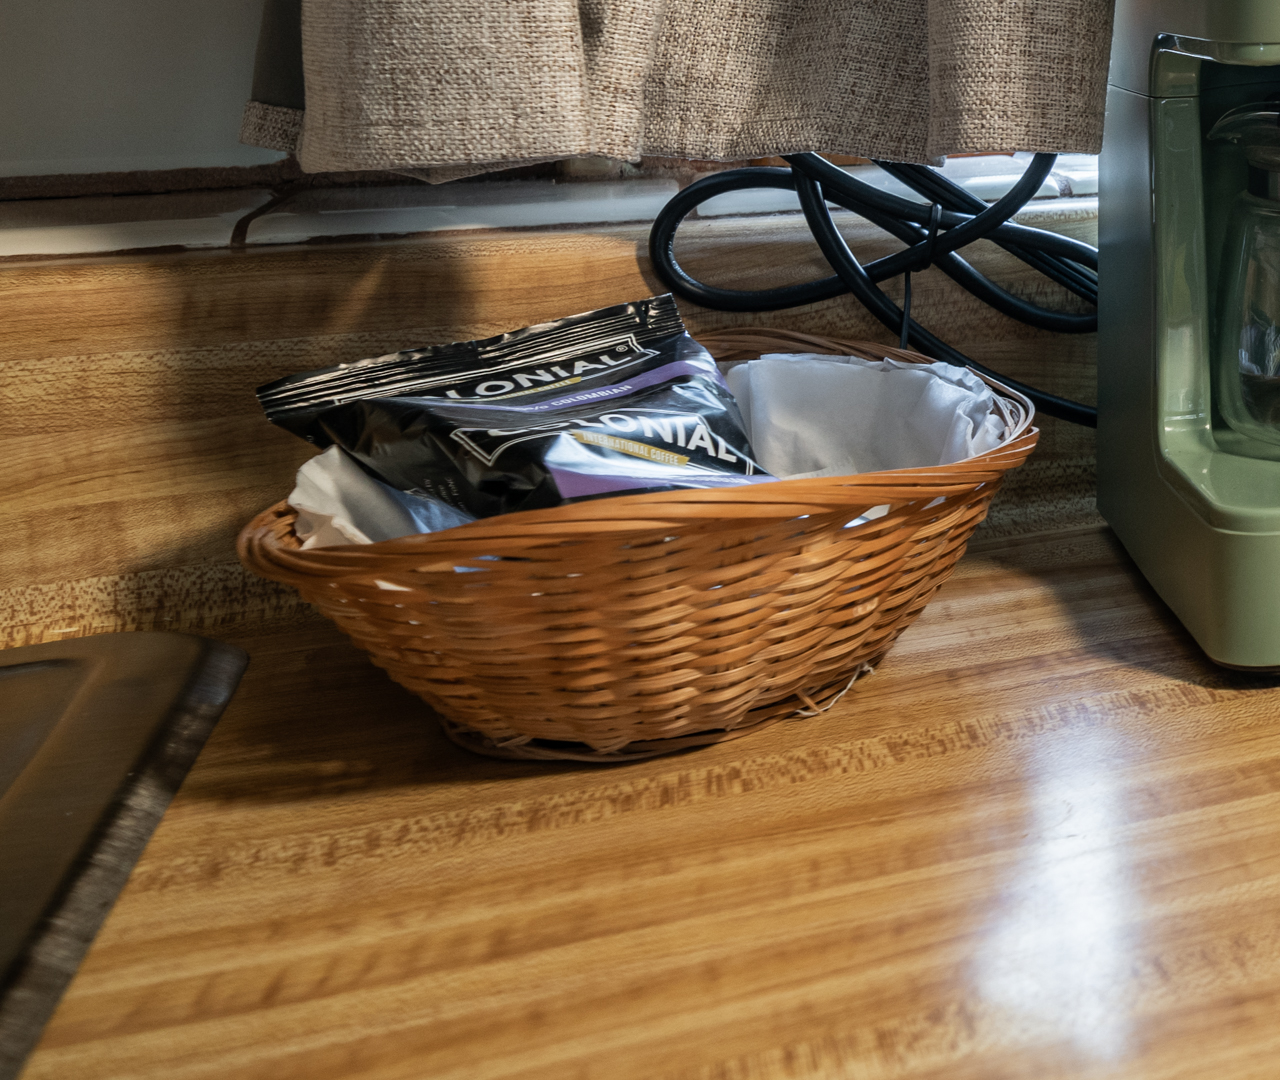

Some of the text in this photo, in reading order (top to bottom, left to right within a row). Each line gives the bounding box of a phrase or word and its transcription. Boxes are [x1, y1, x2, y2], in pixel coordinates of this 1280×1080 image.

[421, 354, 632, 400] LONIAL
[551, 384, 632, 407] COLOMBIAN
[583, 431, 679, 466] INTERNATIONAL COFFEE
